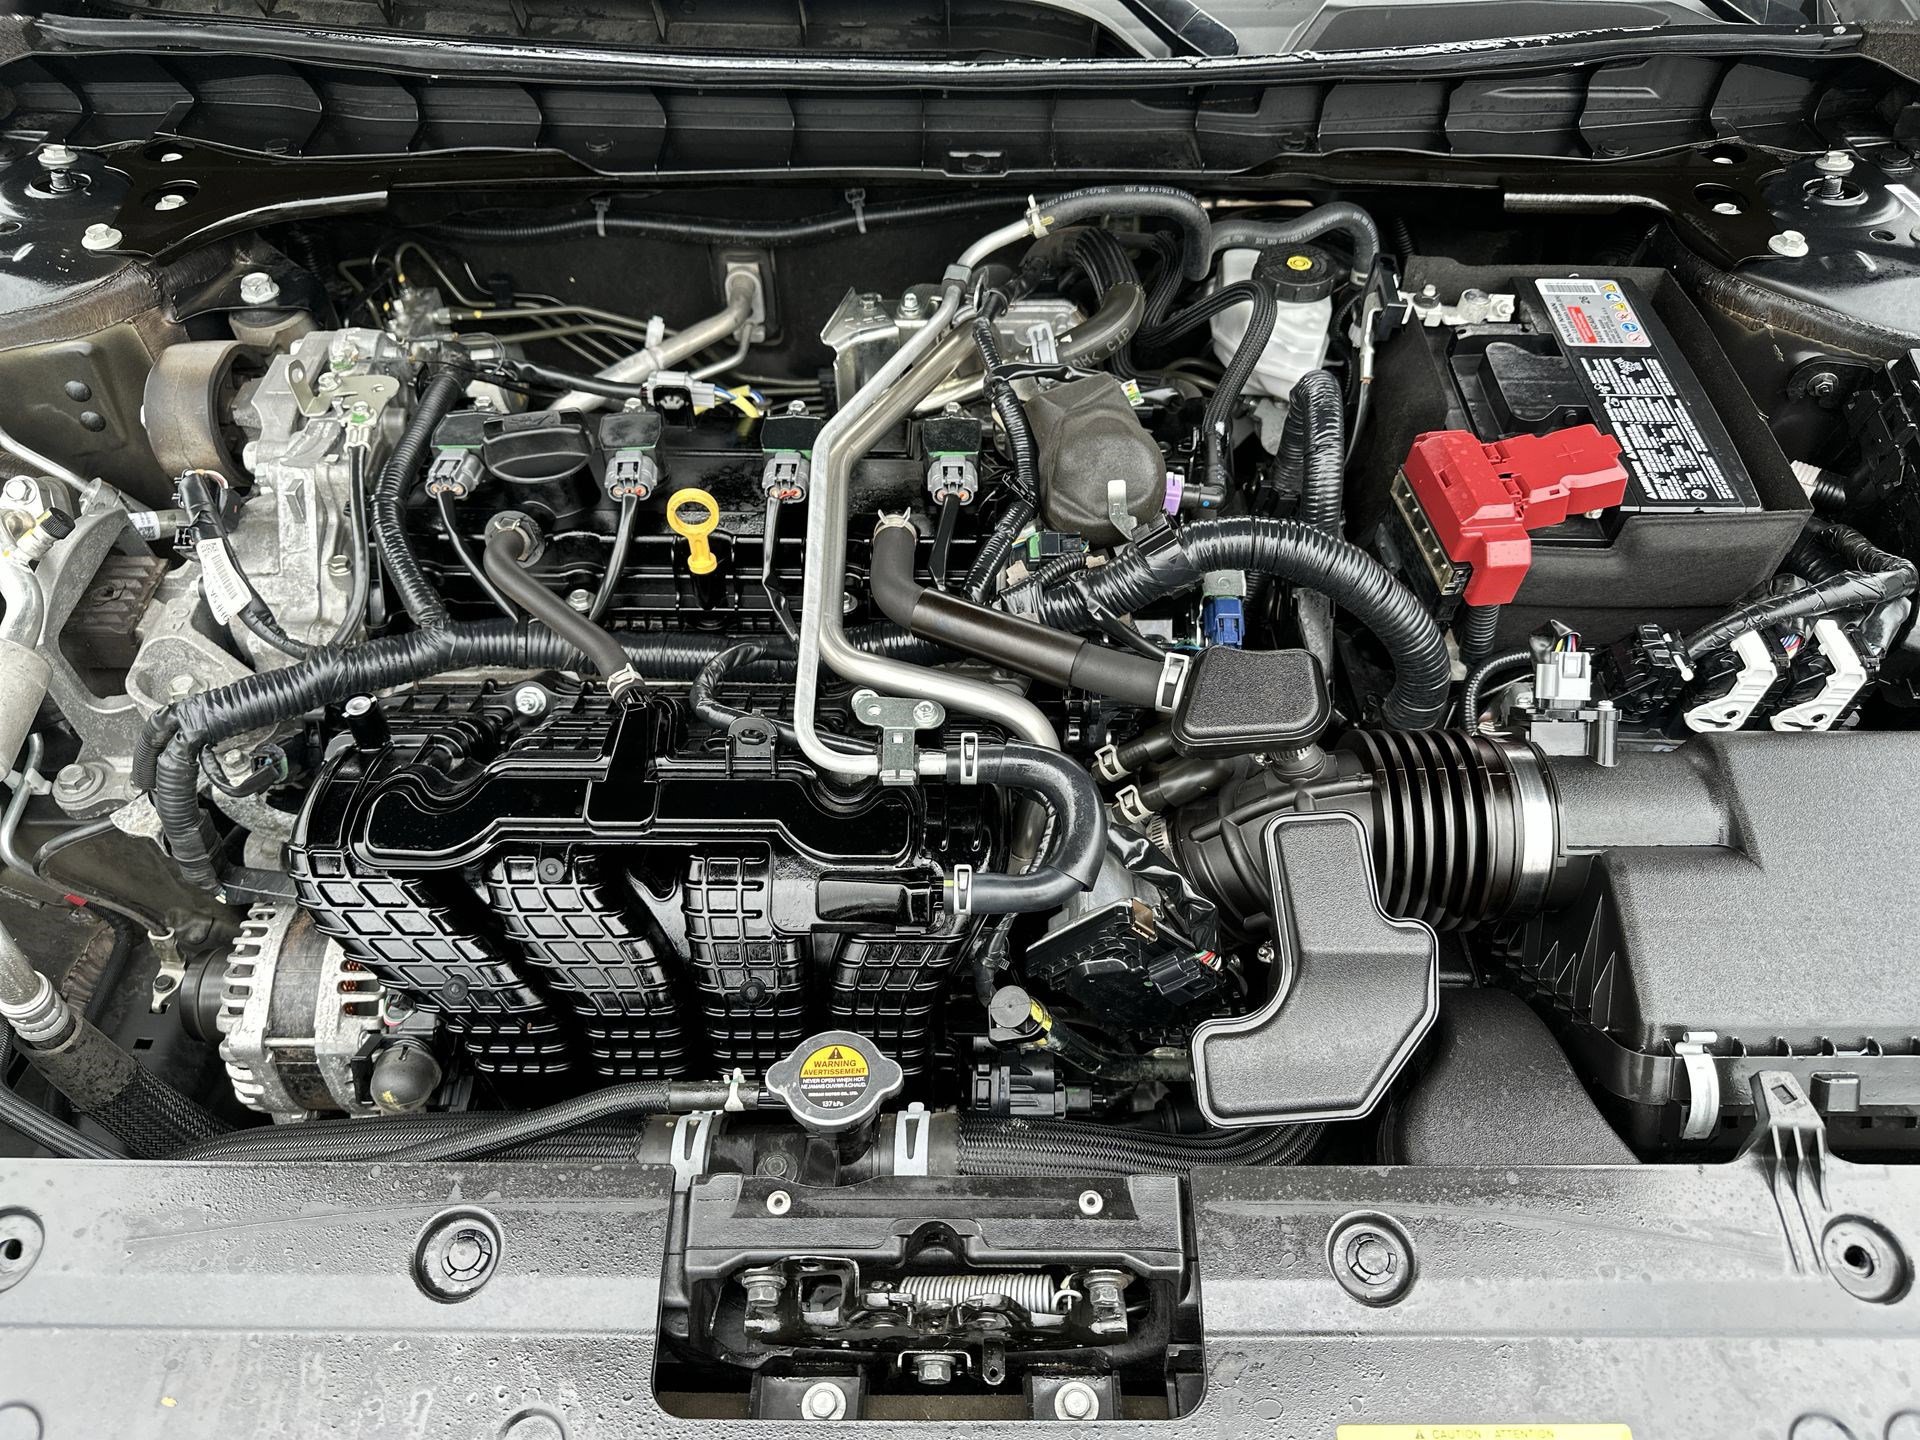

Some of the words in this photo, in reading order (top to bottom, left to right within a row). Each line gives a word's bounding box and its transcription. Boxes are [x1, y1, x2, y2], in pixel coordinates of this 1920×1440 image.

[813, 1060, 856, 1068] WARNING
[803, 1068, 865, 1076] AVERTISSEMENT
[1432, 1429, 1482, 1440] CAUTION
[1495, 1429, 1555, 1440] ATTENTION
